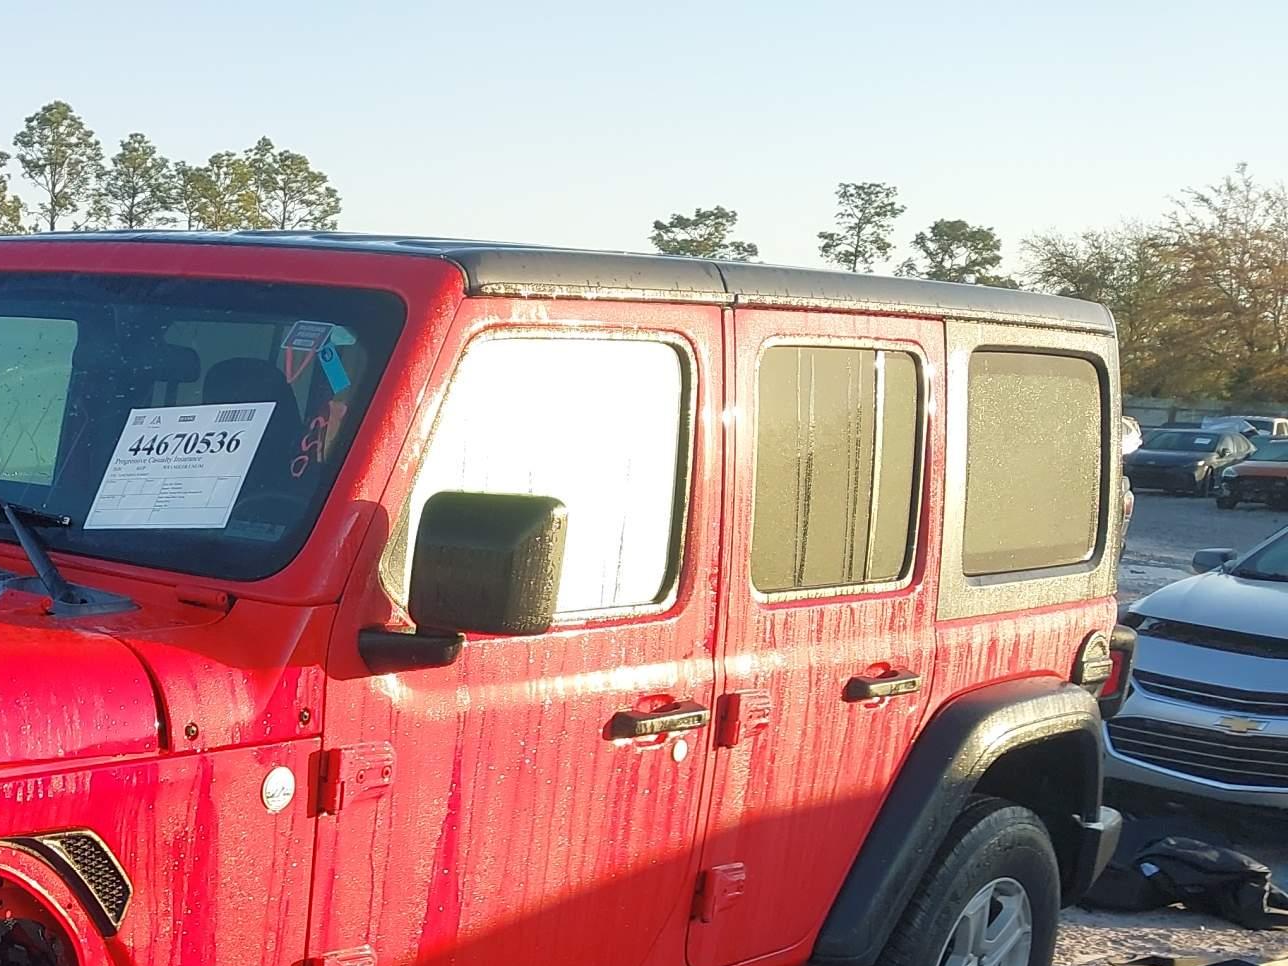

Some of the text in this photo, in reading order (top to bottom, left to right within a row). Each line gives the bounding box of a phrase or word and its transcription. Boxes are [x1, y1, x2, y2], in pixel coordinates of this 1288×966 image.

[128, 430, 246, 457] 44670536
[115, 457, 147, 466] Progressive
[173, 455, 202, 463] Insurance
